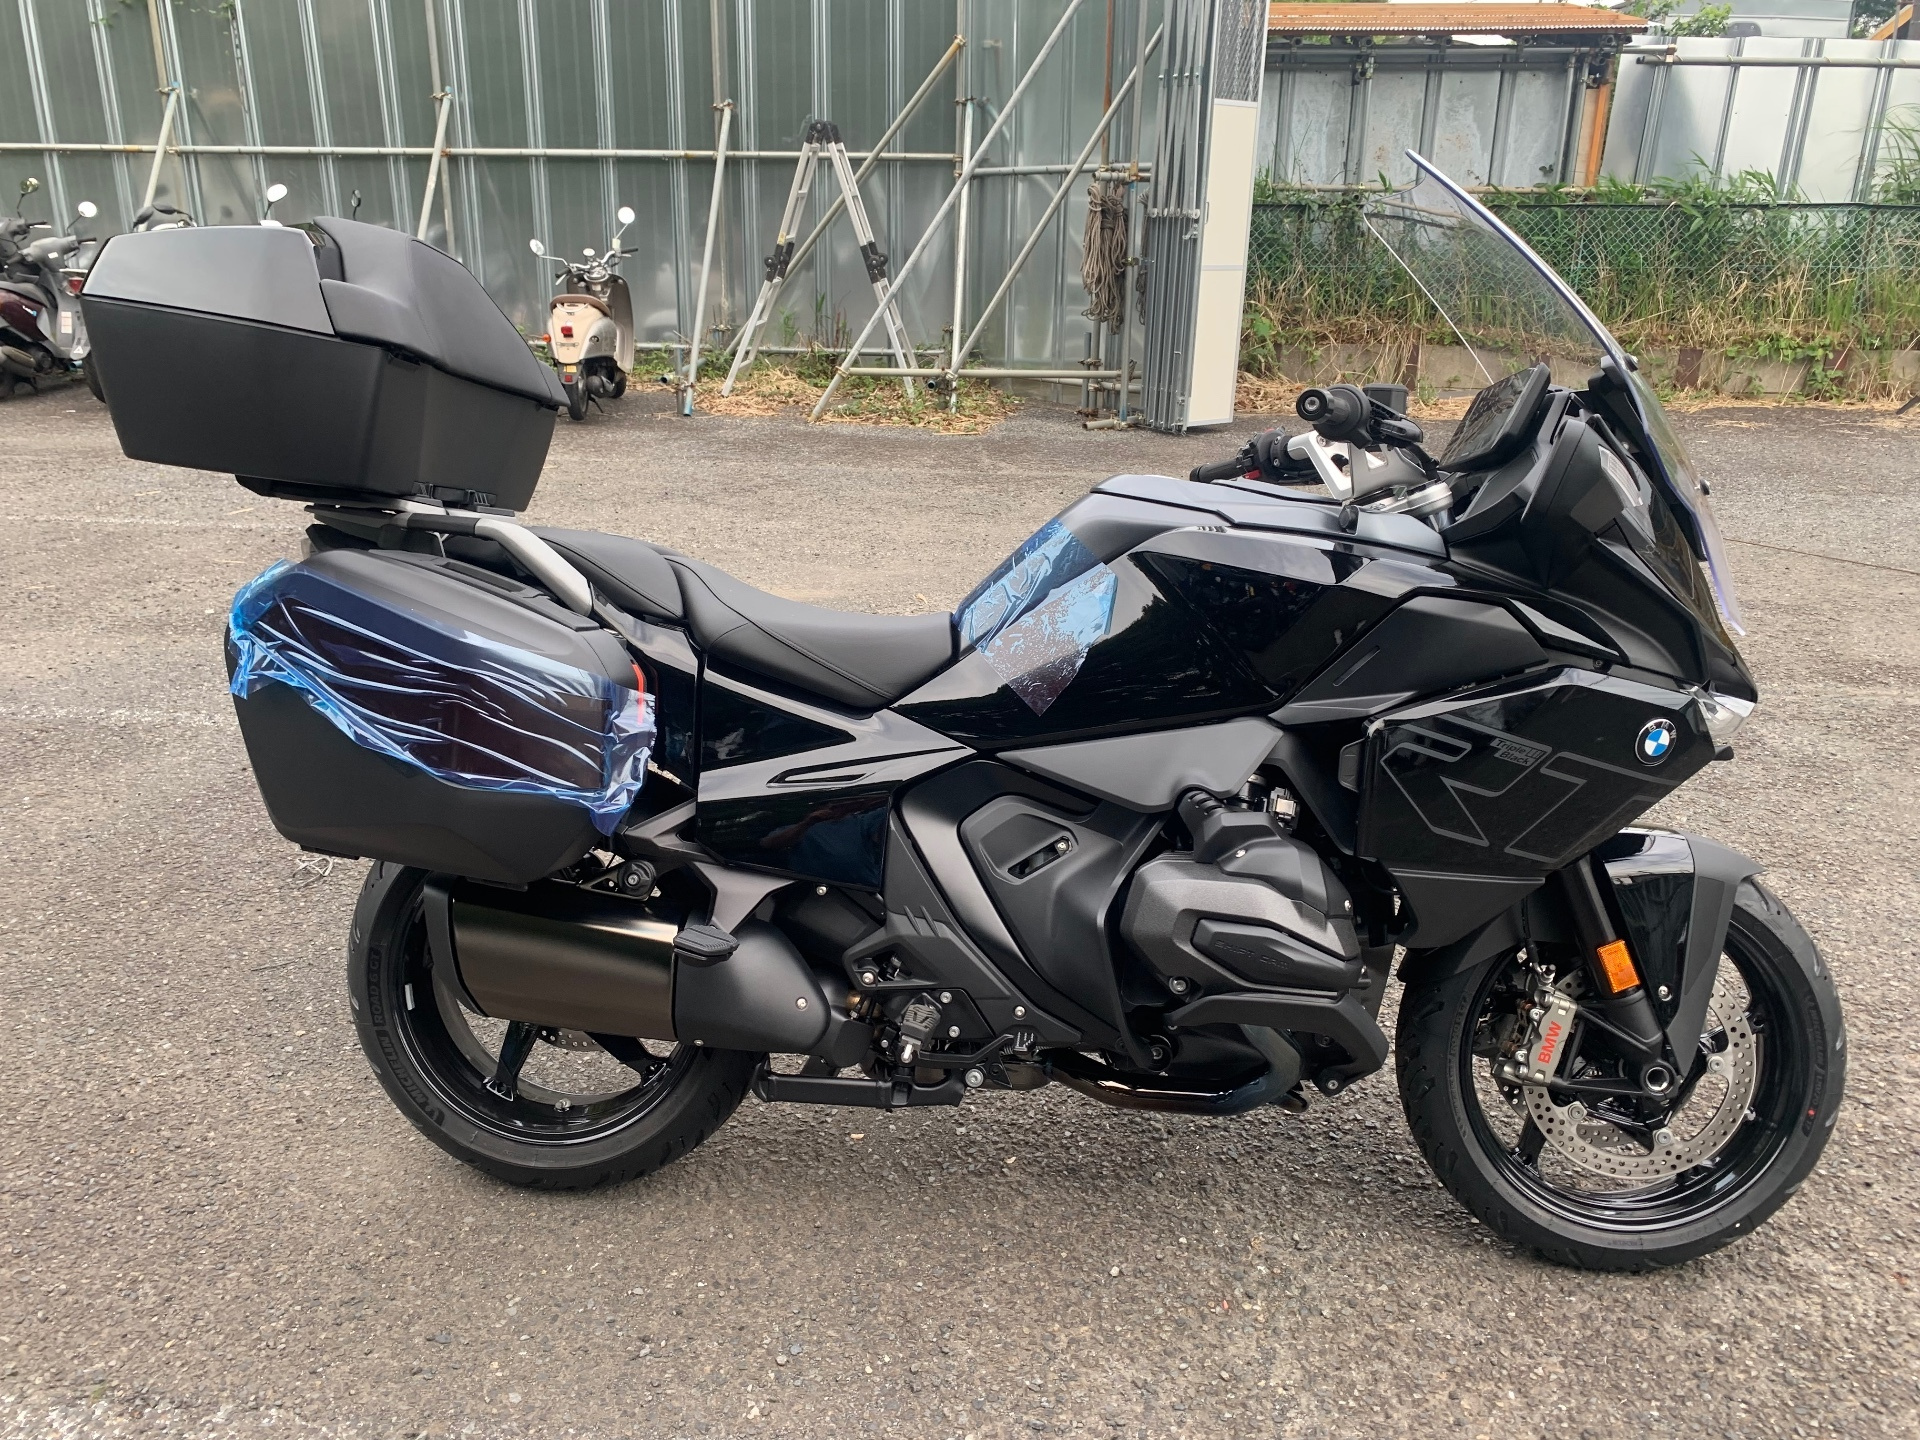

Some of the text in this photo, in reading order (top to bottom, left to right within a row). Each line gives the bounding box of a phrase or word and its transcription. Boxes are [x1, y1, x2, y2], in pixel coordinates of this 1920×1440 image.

[1648, 720, 1677, 739] BMW
[1496, 739, 1527, 754] Triple
[1499, 751, 1531, 765] Black
[368, 952, 385, 1024] ROAD 6 GT
[1537, 1021, 1562, 1064] BMW
[378, 1035, 427, 1104] MICHELIN
